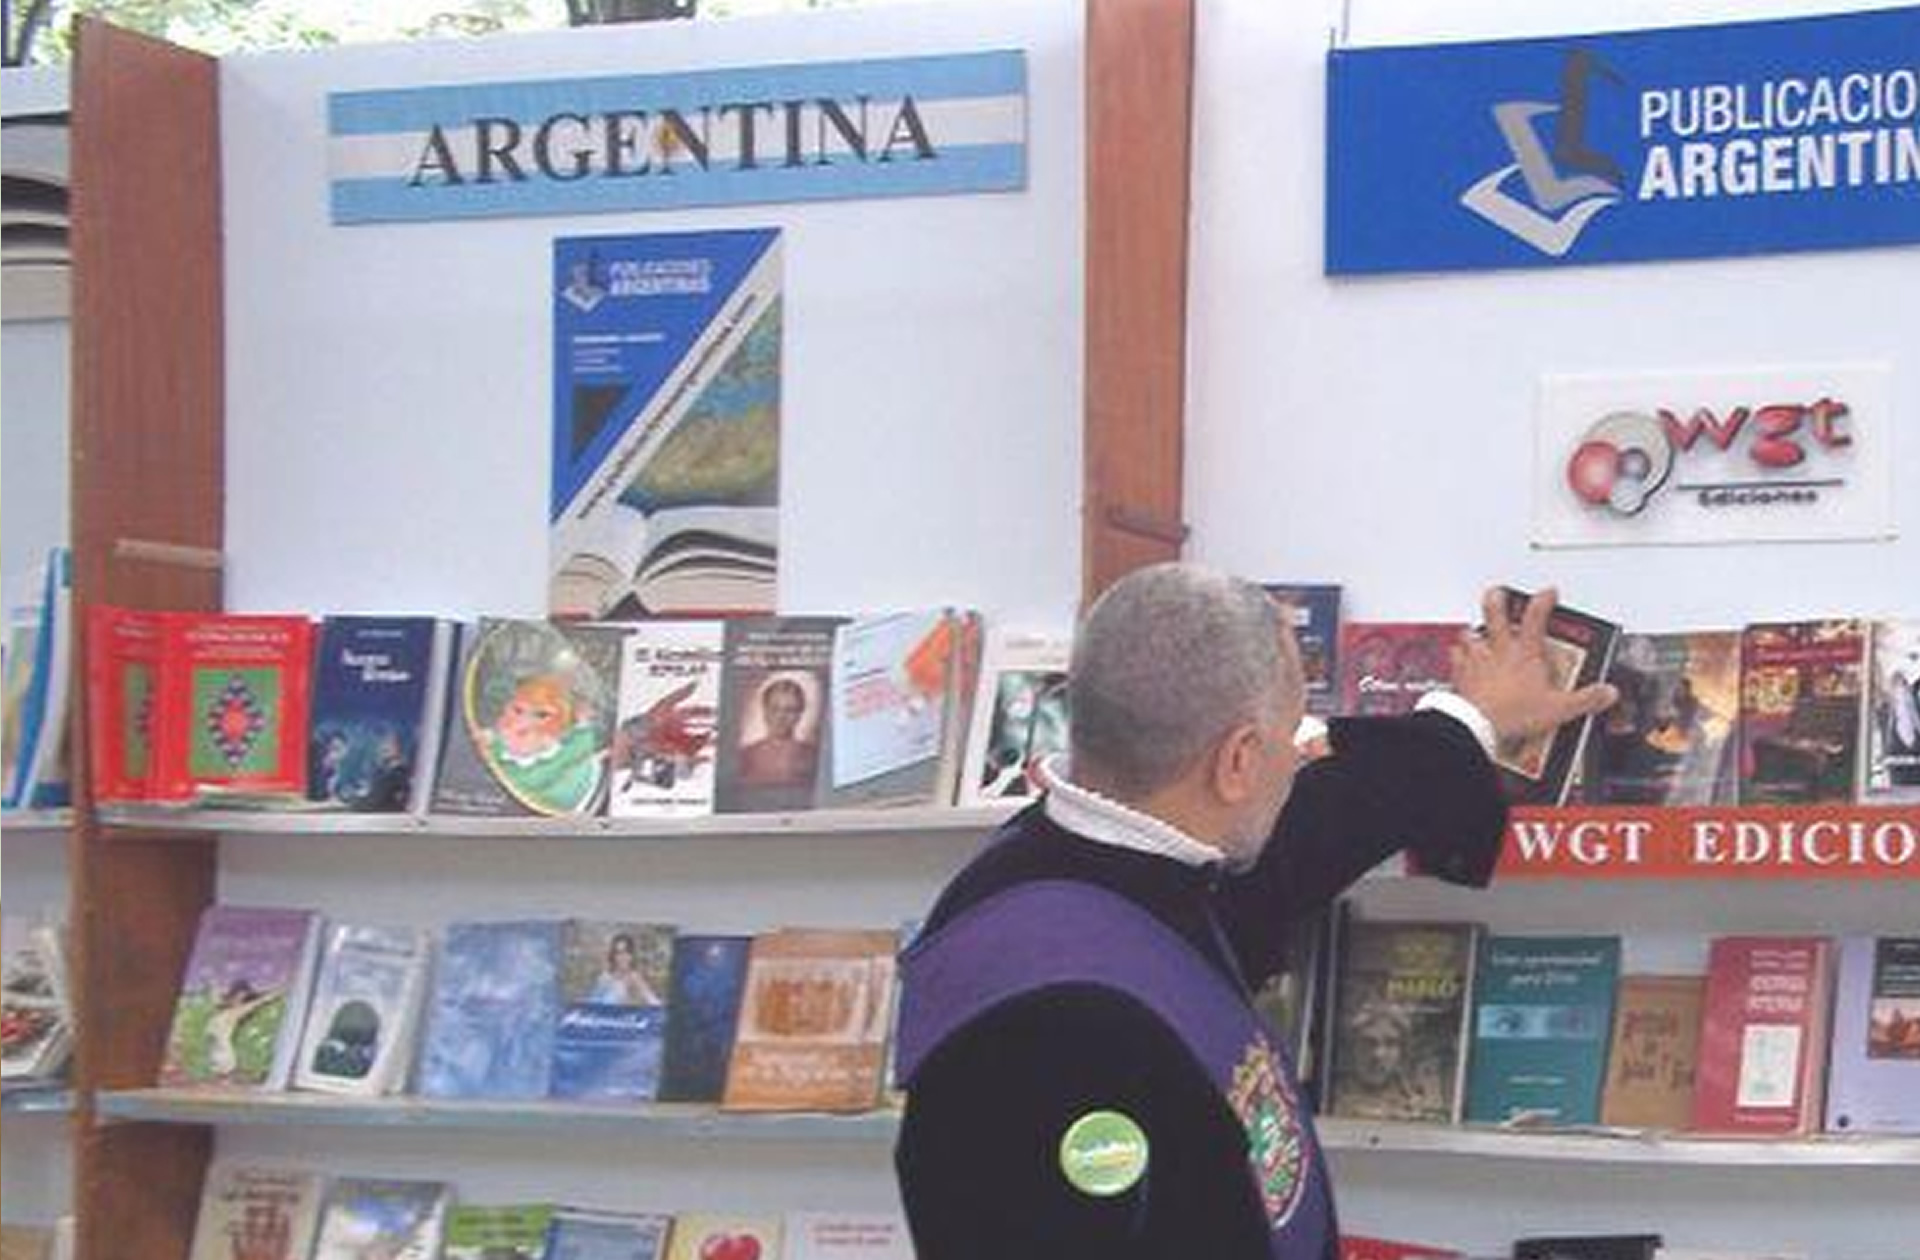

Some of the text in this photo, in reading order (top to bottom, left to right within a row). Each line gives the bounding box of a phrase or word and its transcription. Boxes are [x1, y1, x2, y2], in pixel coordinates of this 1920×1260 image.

[1640, 69, 1918, 138] PUBLICACIO
[409, 93, 938, 187] ARGENTINA
[1637, 127, 1920, 200] ARGENTIN
[1656, 396, 1852, 468] wgt
[1697, 488, 1820, 507] Ediciones
[1511, 821, 1917, 865] WGT EDICIO
